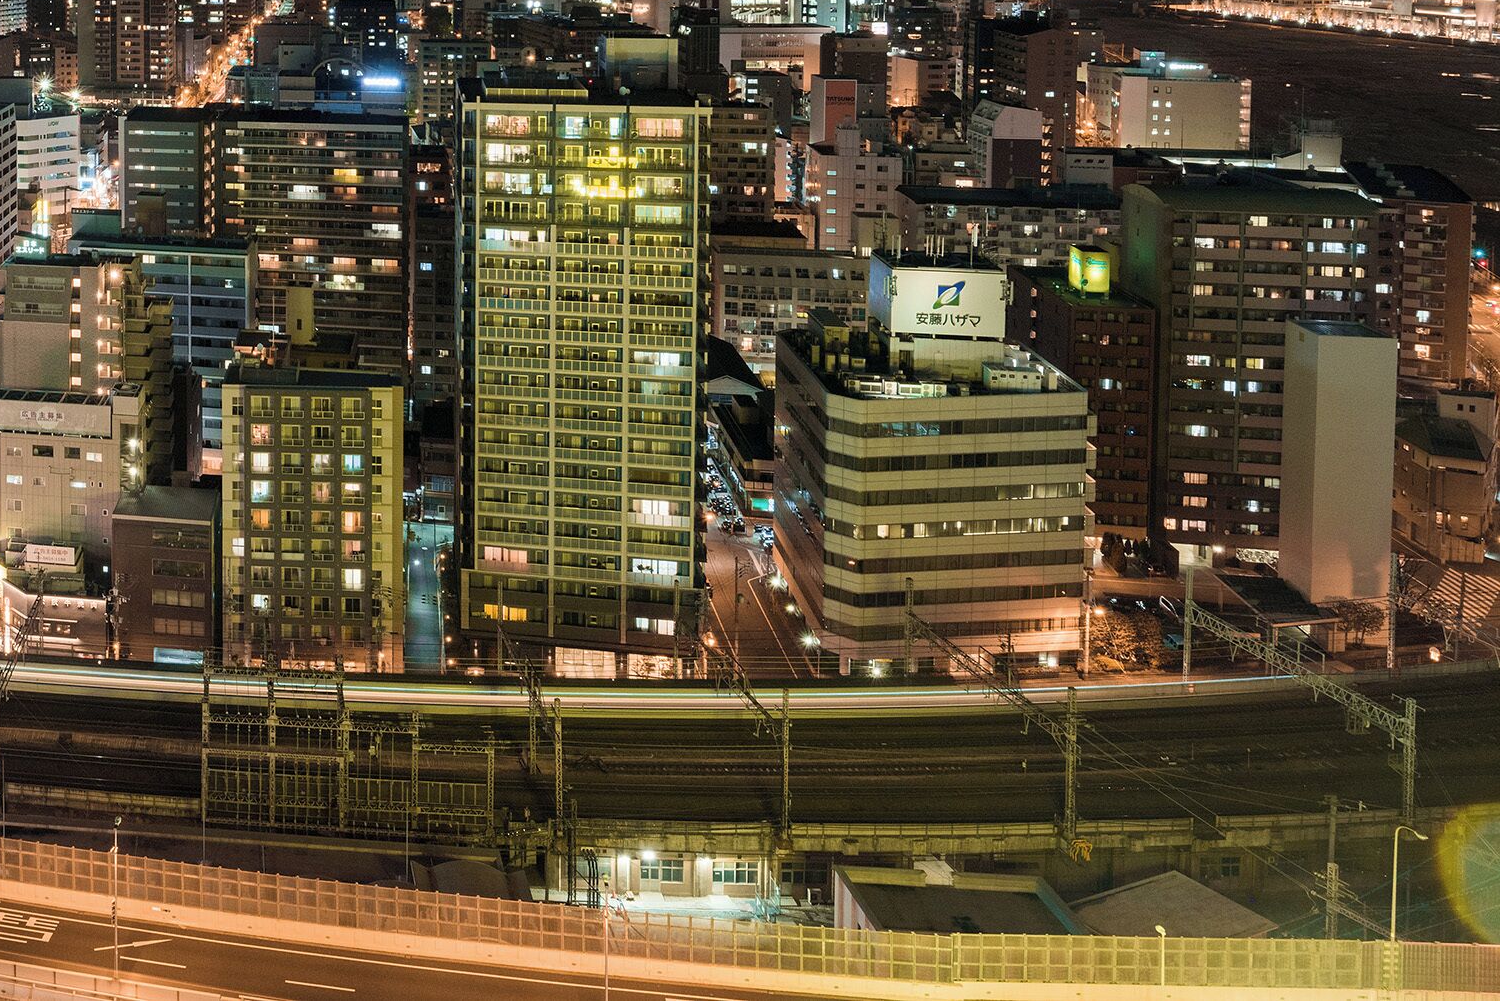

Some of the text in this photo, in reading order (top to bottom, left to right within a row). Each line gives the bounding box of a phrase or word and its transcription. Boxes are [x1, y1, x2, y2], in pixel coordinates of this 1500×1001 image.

[15, 246, 45, 254] エスリード
[915, 312, 981, 328] 安藤ハザマ
